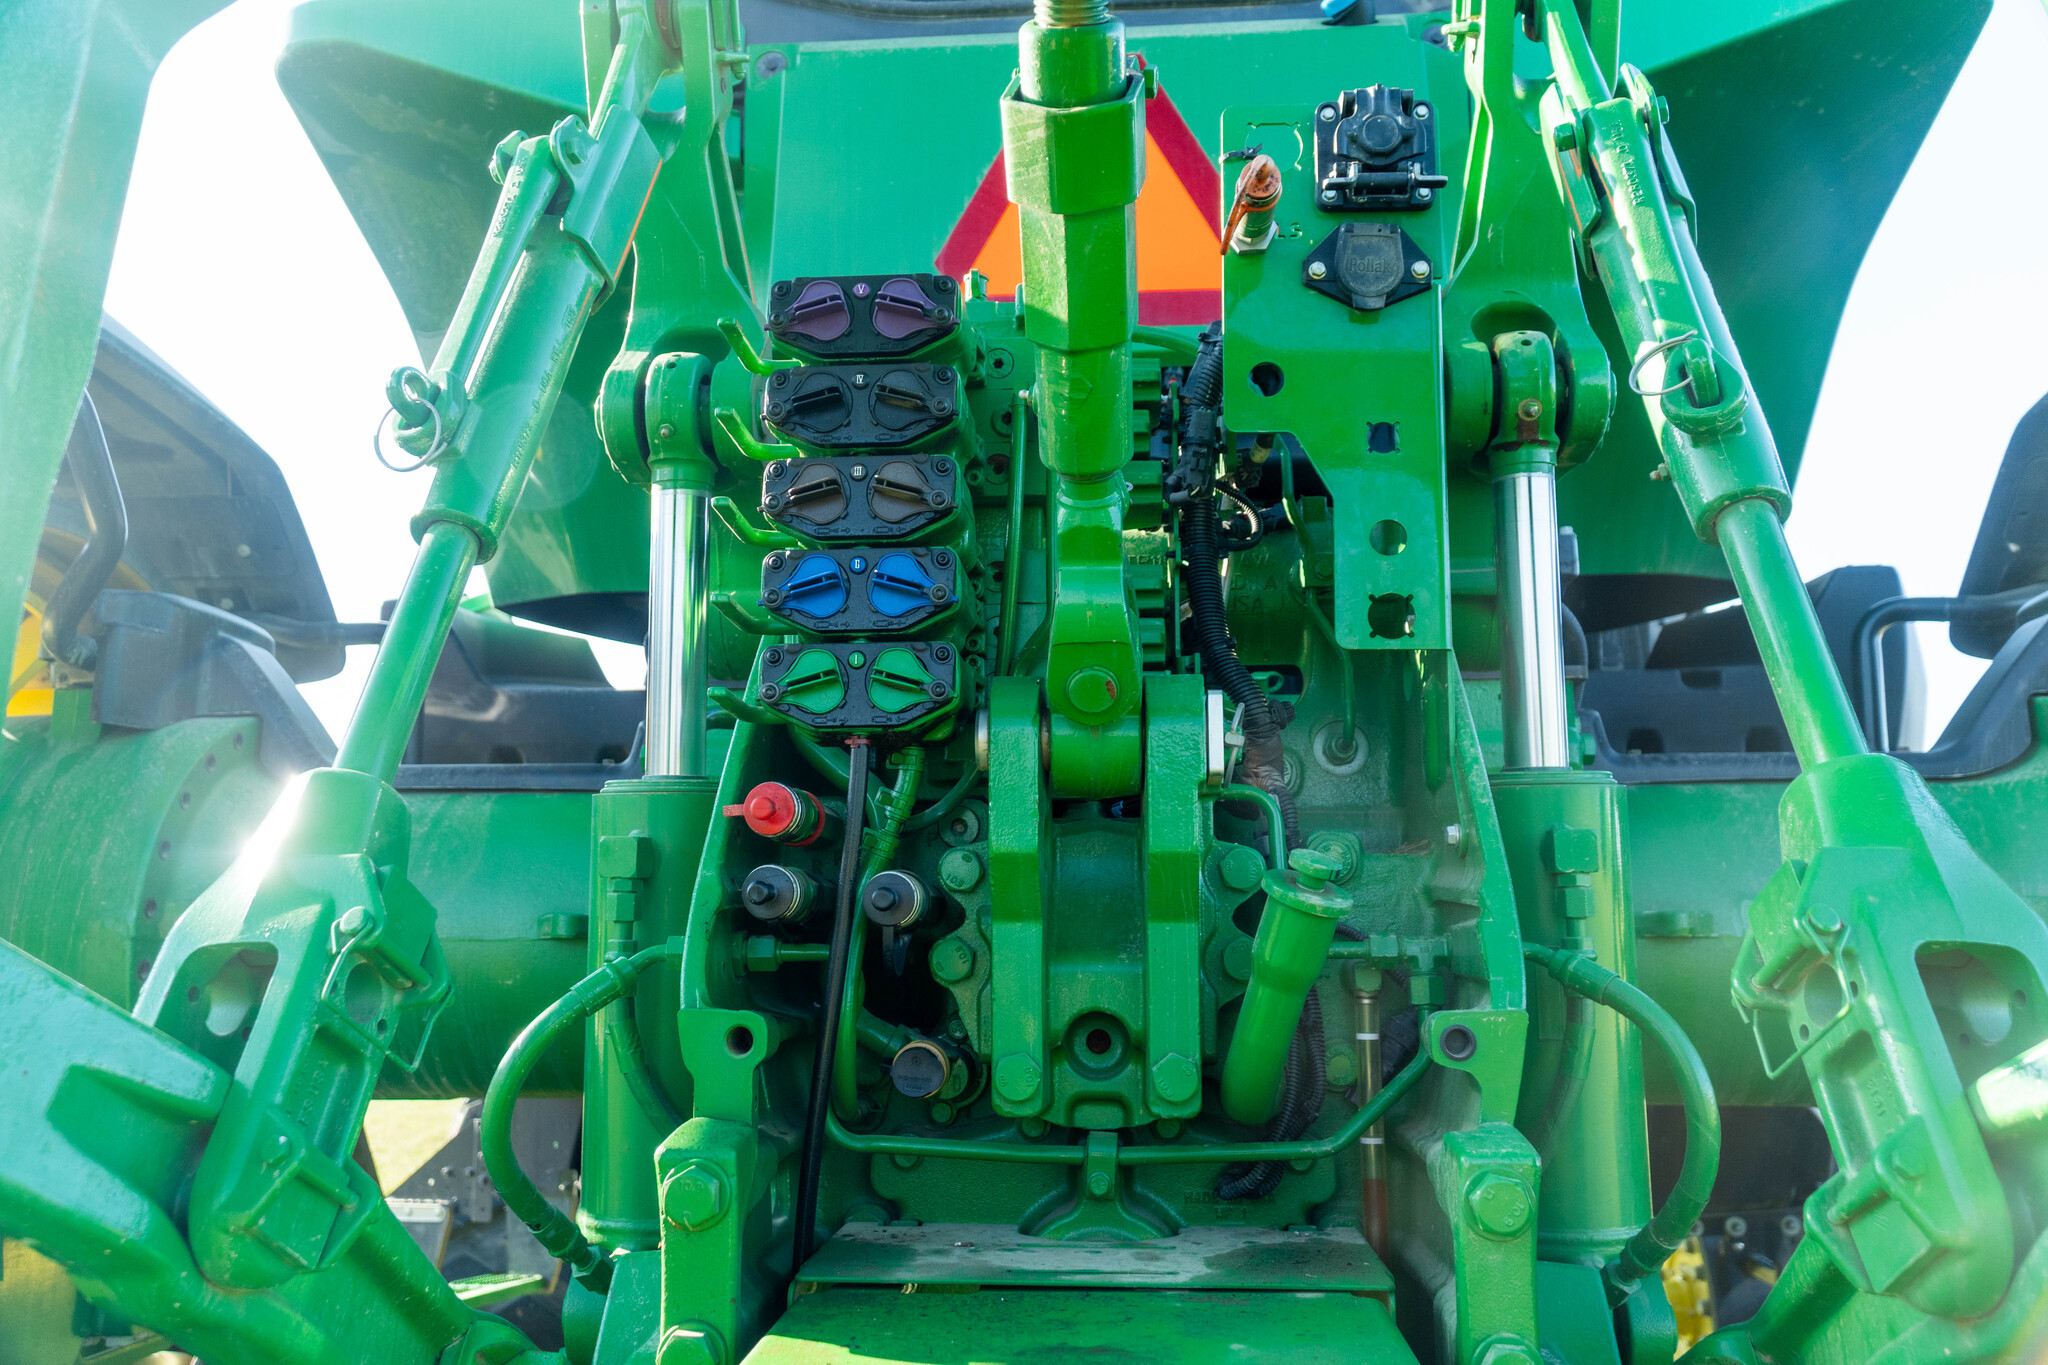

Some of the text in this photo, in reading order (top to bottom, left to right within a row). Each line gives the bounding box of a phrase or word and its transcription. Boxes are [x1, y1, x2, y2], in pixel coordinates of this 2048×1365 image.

[1348, 256, 1390, 273] Pollak
[857, 284, 864, 294] V
[855, 374, 864, 384] IV
[853, 466, 862, 476] III
[945, 873, 965, 888] 10.9
[954, 945, 970, 963] 10.9
[1023, 1066, 1034, 1087] 10.9
[1158, 1078, 1175, 1097] 10.9
